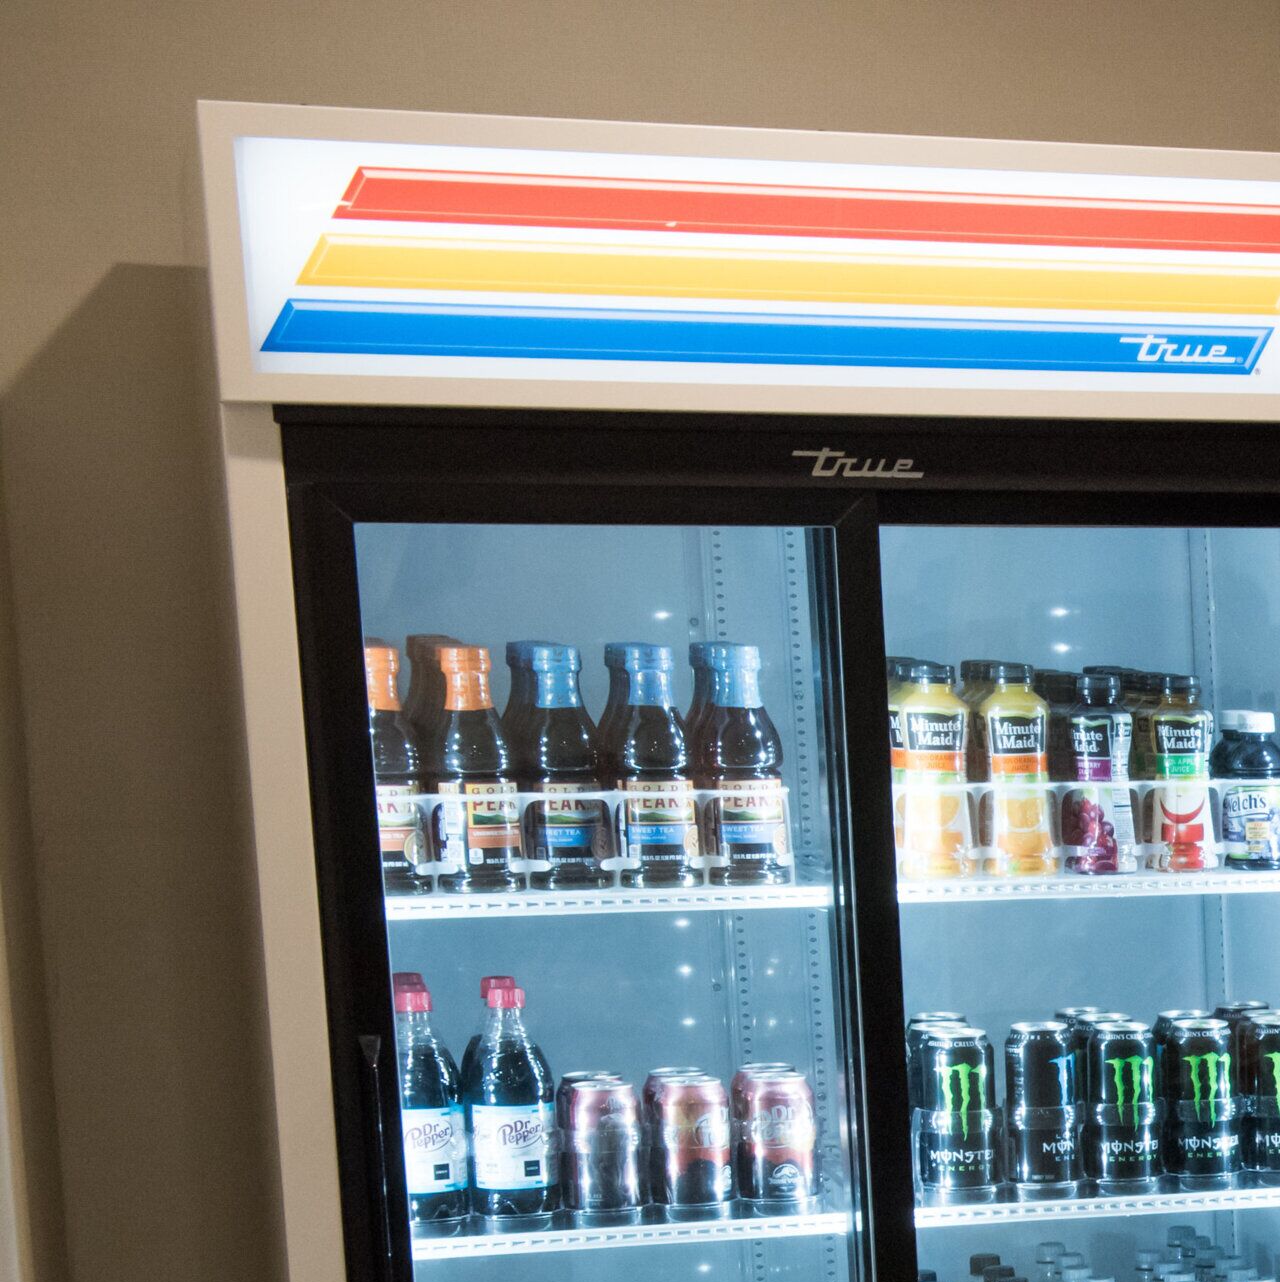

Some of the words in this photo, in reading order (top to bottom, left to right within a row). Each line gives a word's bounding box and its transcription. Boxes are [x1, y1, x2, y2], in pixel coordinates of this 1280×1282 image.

[1119, 334, 1237, 364] true
[791, 446, 925, 479] true
[910, 717, 962, 732] Minute
[995, 720, 1041, 735] Minute
[1157, 725, 1202, 738] Minute
[917, 732, 954, 746] Maid
[1001, 735, 1036, 749] Maid
[1073, 729, 1103, 741] inute
[1164, 738, 1191, 750] Maid
[421, 1122, 439, 1135] Dr
[514, 1119, 531, 1132] Dr
[410, 1125, 451, 1149] Pepper
[501, 1122, 541, 1146] Pepper
